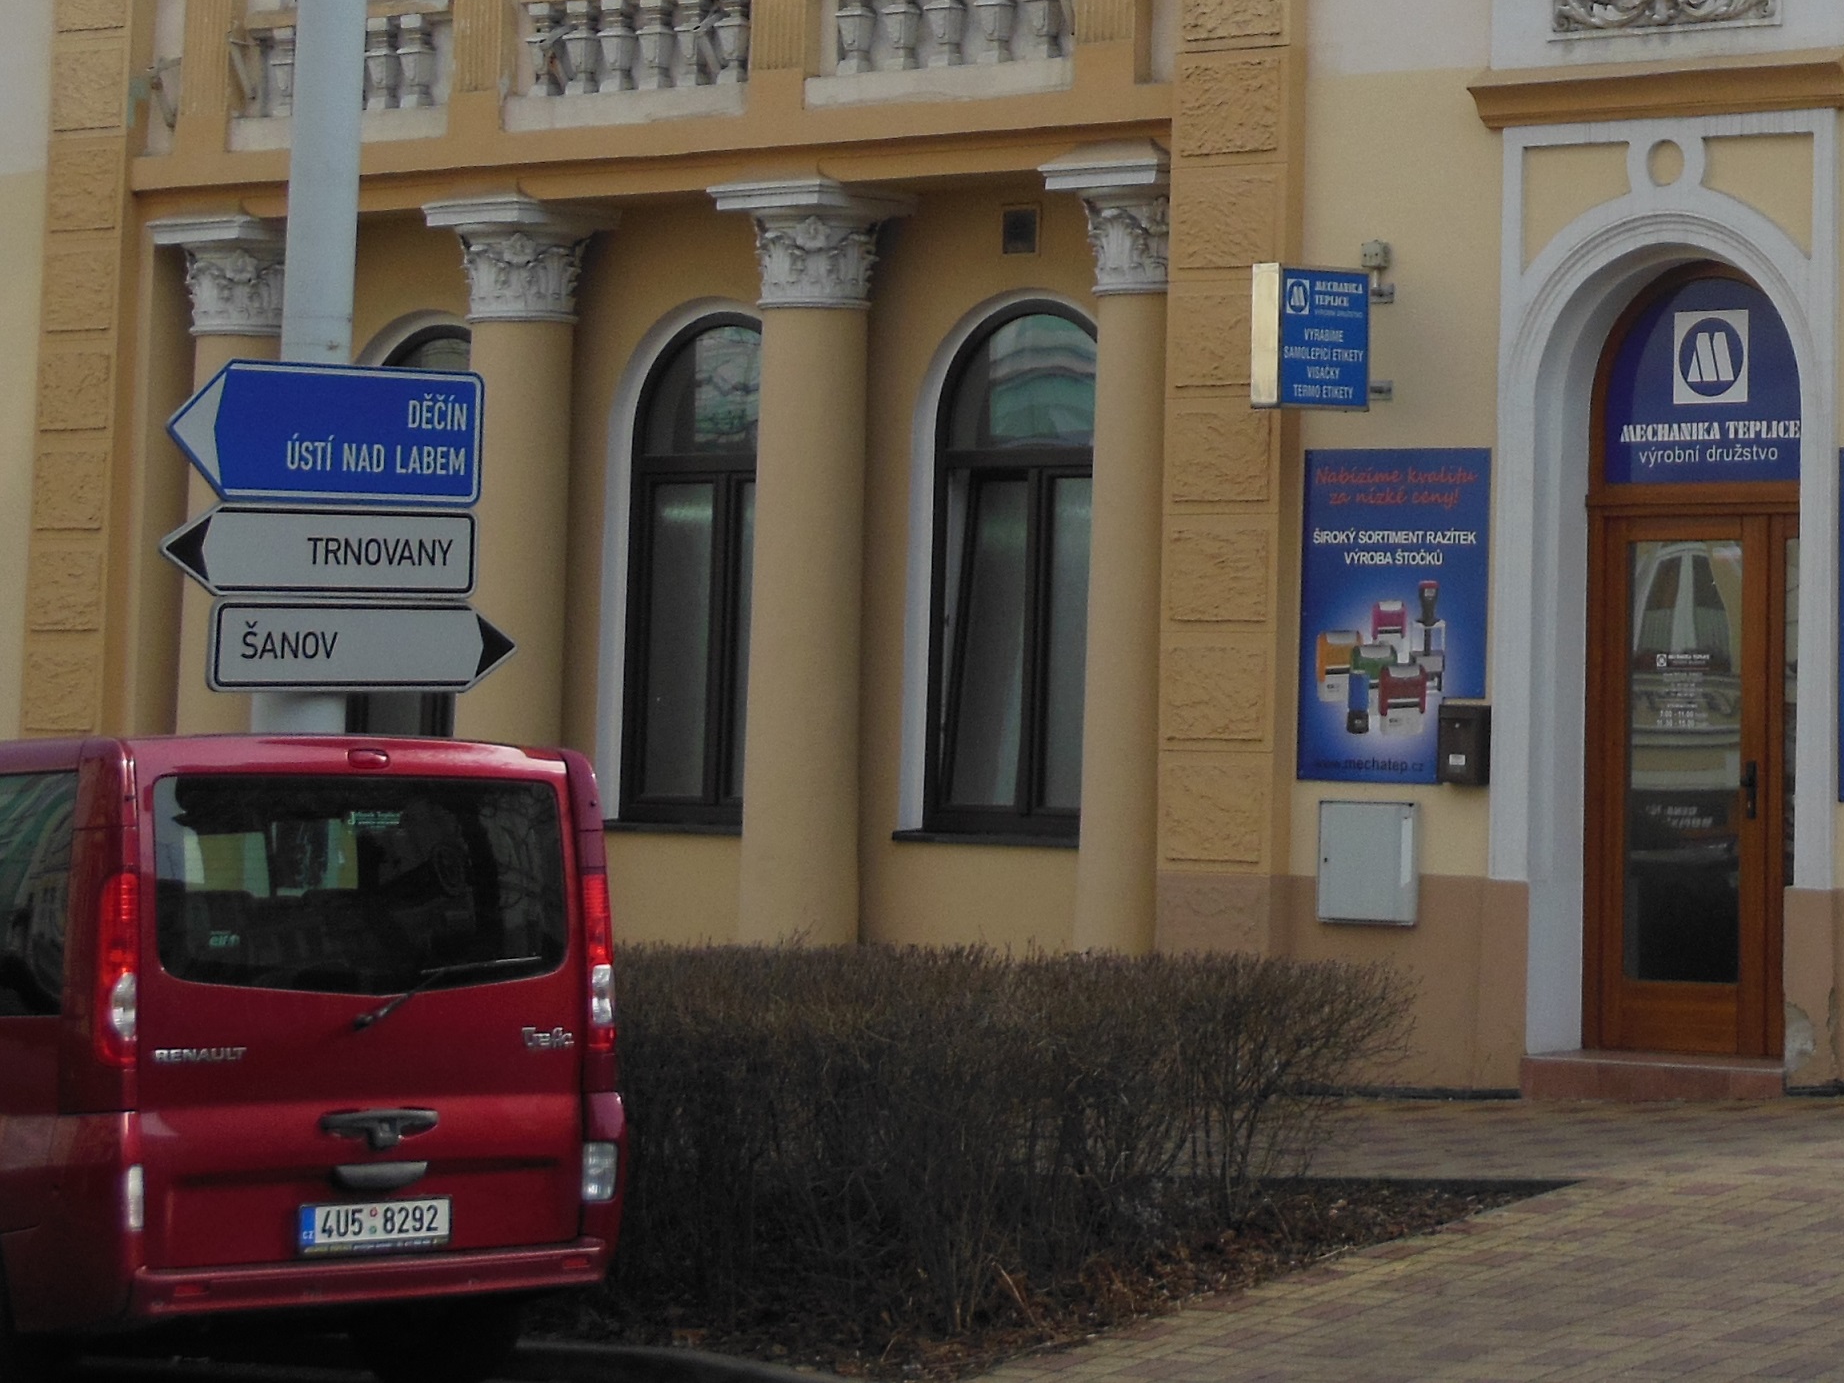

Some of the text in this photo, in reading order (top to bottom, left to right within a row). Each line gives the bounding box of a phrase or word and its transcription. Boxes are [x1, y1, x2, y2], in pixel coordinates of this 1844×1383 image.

[1292, 383, 1320, 398] TERMO
[407, 393, 468, 432] DĚČÍN
[1620, 420, 1801, 443] MECHANIKA TEPLICE
[286, 433, 467, 476] ÚSTÍ NAD LABEM
[1638, 443, 1778, 468] výrobní družstvo
[1329, 485, 1462, 511] za nízké ceny!
[1312, 527, 1477, 545] ŠIROKÝ SORTIMENT RAZÍTEK
[307, 537, 453, 567] TRNOVANY
[1344, 548, 1393, 565] VÝROBA
[241, 621, 339, 661] ŠANOV
[152, 1046, 248, 1063] RENAULT
[302, 1204, 439, 1240] CZ 4U5 8292
